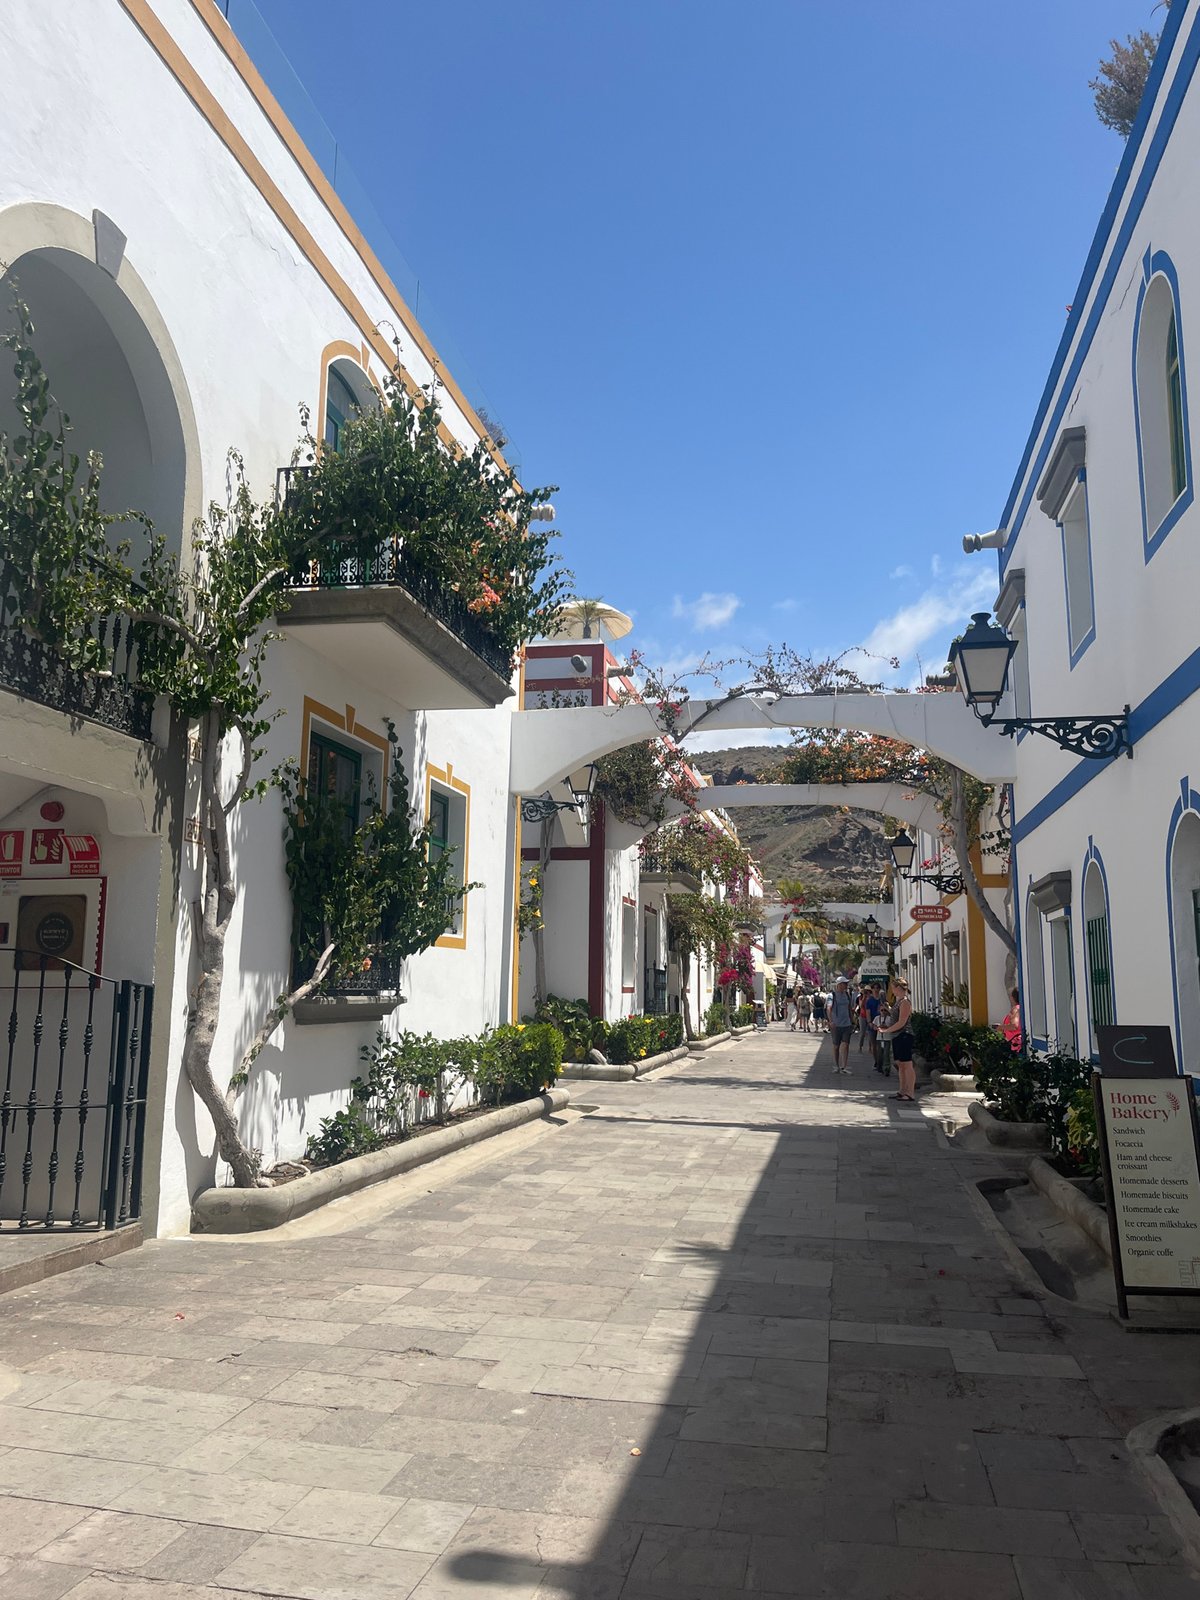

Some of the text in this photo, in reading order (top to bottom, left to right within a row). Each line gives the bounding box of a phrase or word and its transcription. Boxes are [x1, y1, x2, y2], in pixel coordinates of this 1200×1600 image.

[1110, 1092, 1157, 1105] Home
[1111, 1107, 1171, 1122] Bakery
[1112, 1126, 1146, 1135] Sandwich
[1114, 1140, 1144, 1148] Focaccia
[1116, 1153, 1173, 1162] Ham and cheese
[1119, 1176, 1189, 1186] Homemade desserts
[1121, 1191, 1189, 1200] Homemade biscuits
[1122, 1205, 1180, 1214] Homemade cake
[1124, 1220, 1135, 1228] Ice
[1159, 1220, 1198, 1229] milkshakes
[1125, 1233, 1162, 1242] Smoothies
[1127, 1247, 1174, 1257] Organic coffe
